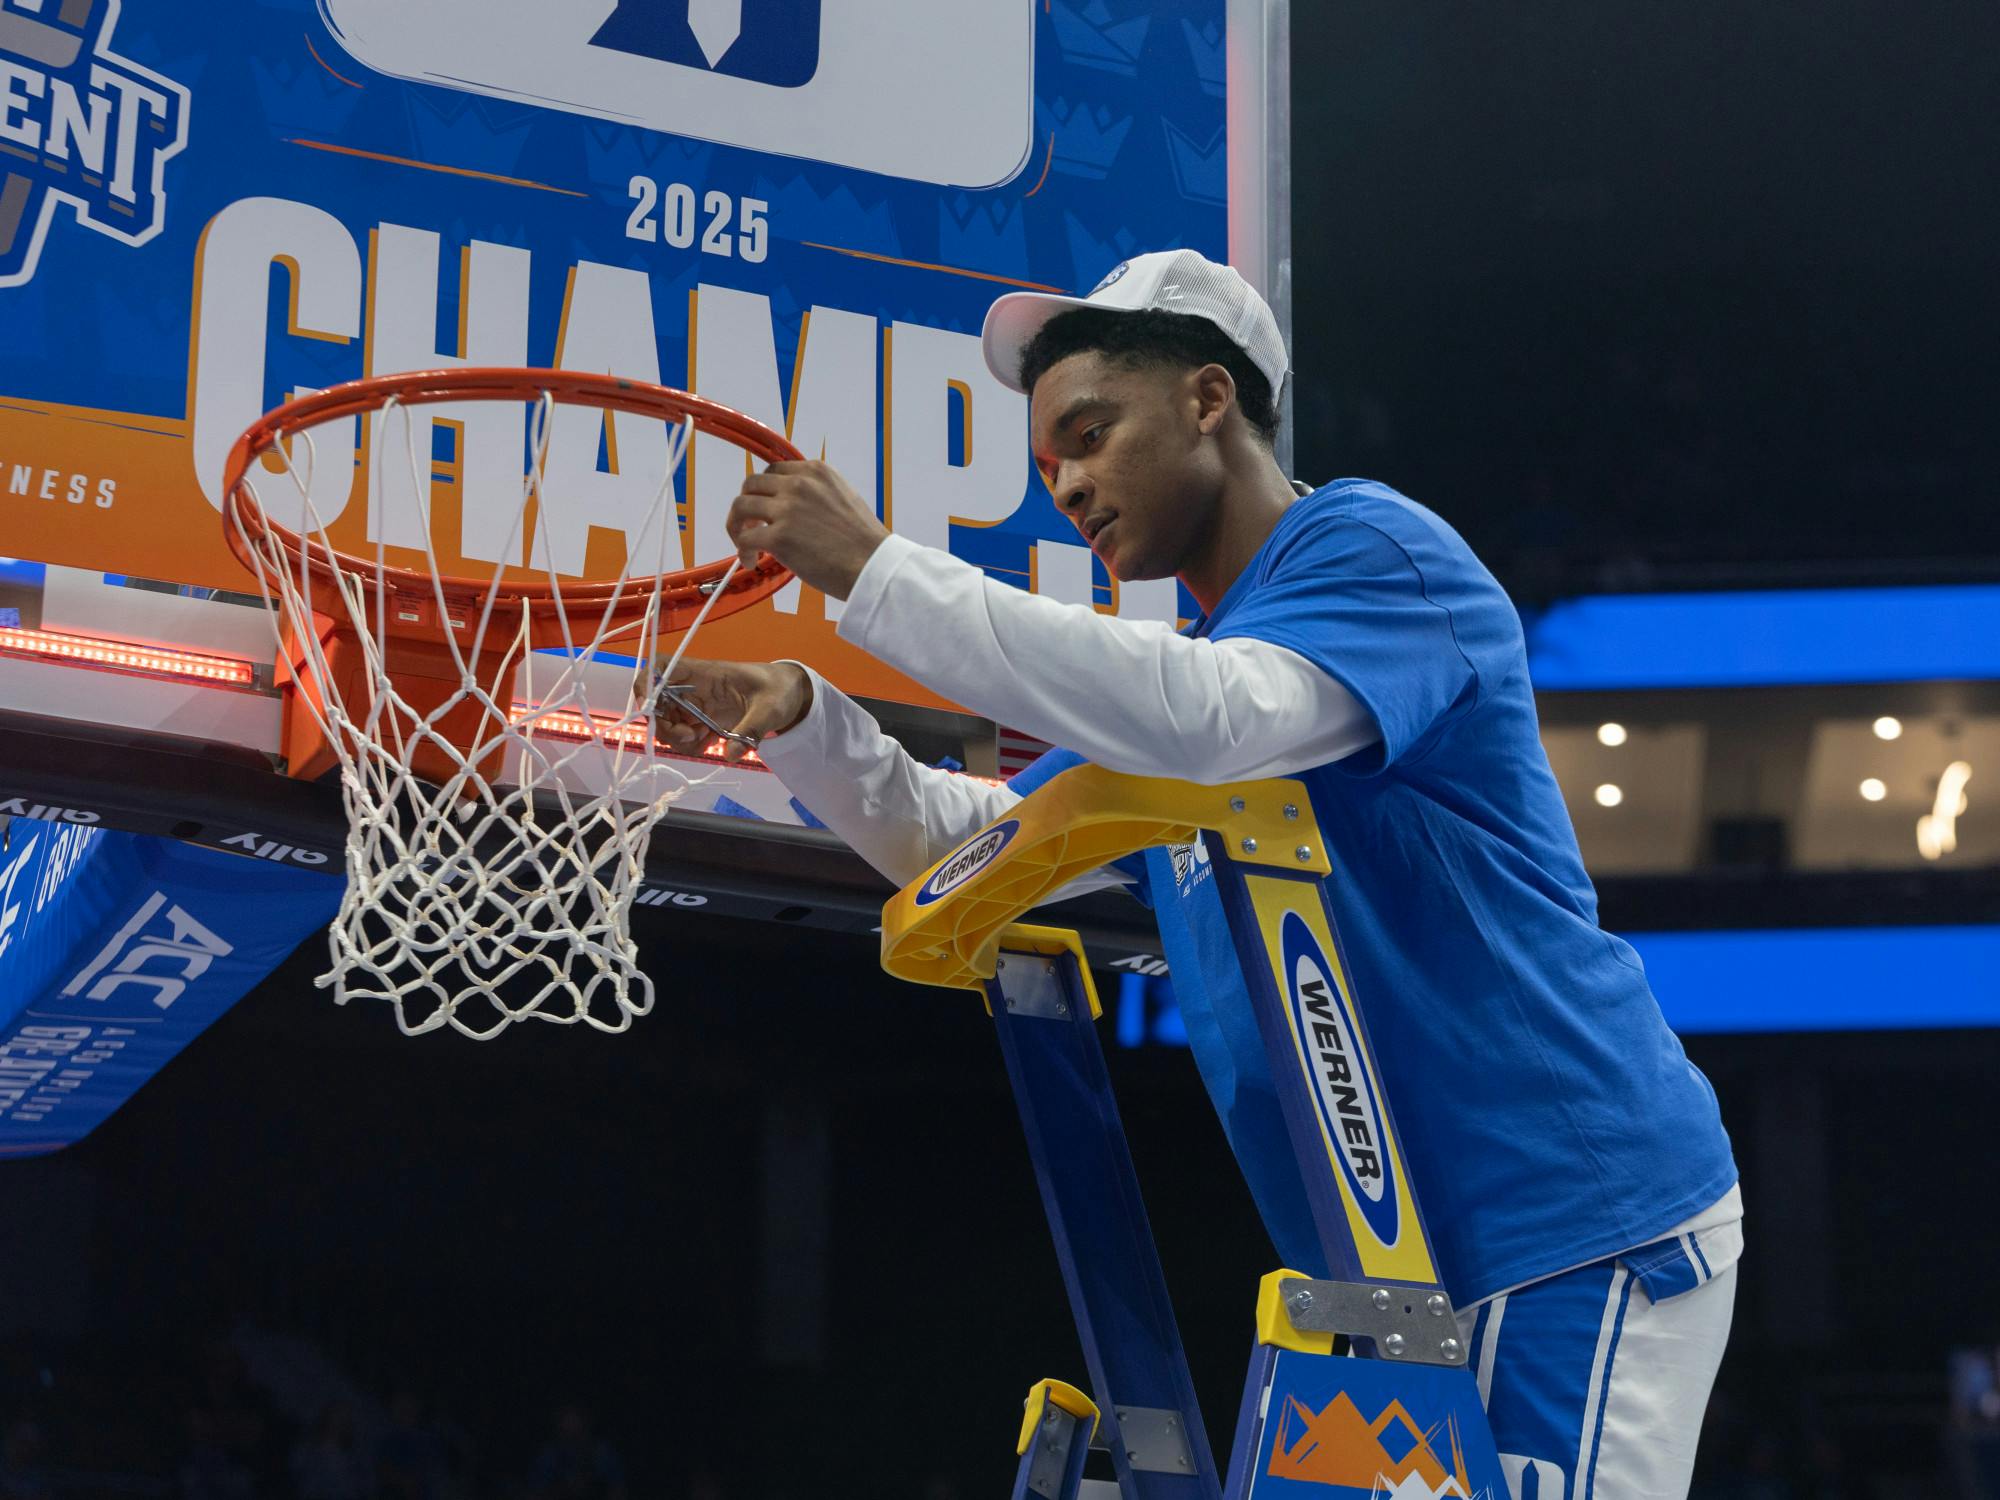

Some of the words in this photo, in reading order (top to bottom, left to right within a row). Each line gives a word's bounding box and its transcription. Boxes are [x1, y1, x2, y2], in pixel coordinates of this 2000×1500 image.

[625, 175, 769, 264] 2025
[192, 195, 1179, 634] CHAMP
[0, 462, 117, 509] NESS
[219, 832, 329, 865] ally
[935, 833, 1000, 893] WERNER
[634, 883, 709, 907] all
[85, 903, 235, 1011] ACC
[1107, 953, 1169, 977] lly
